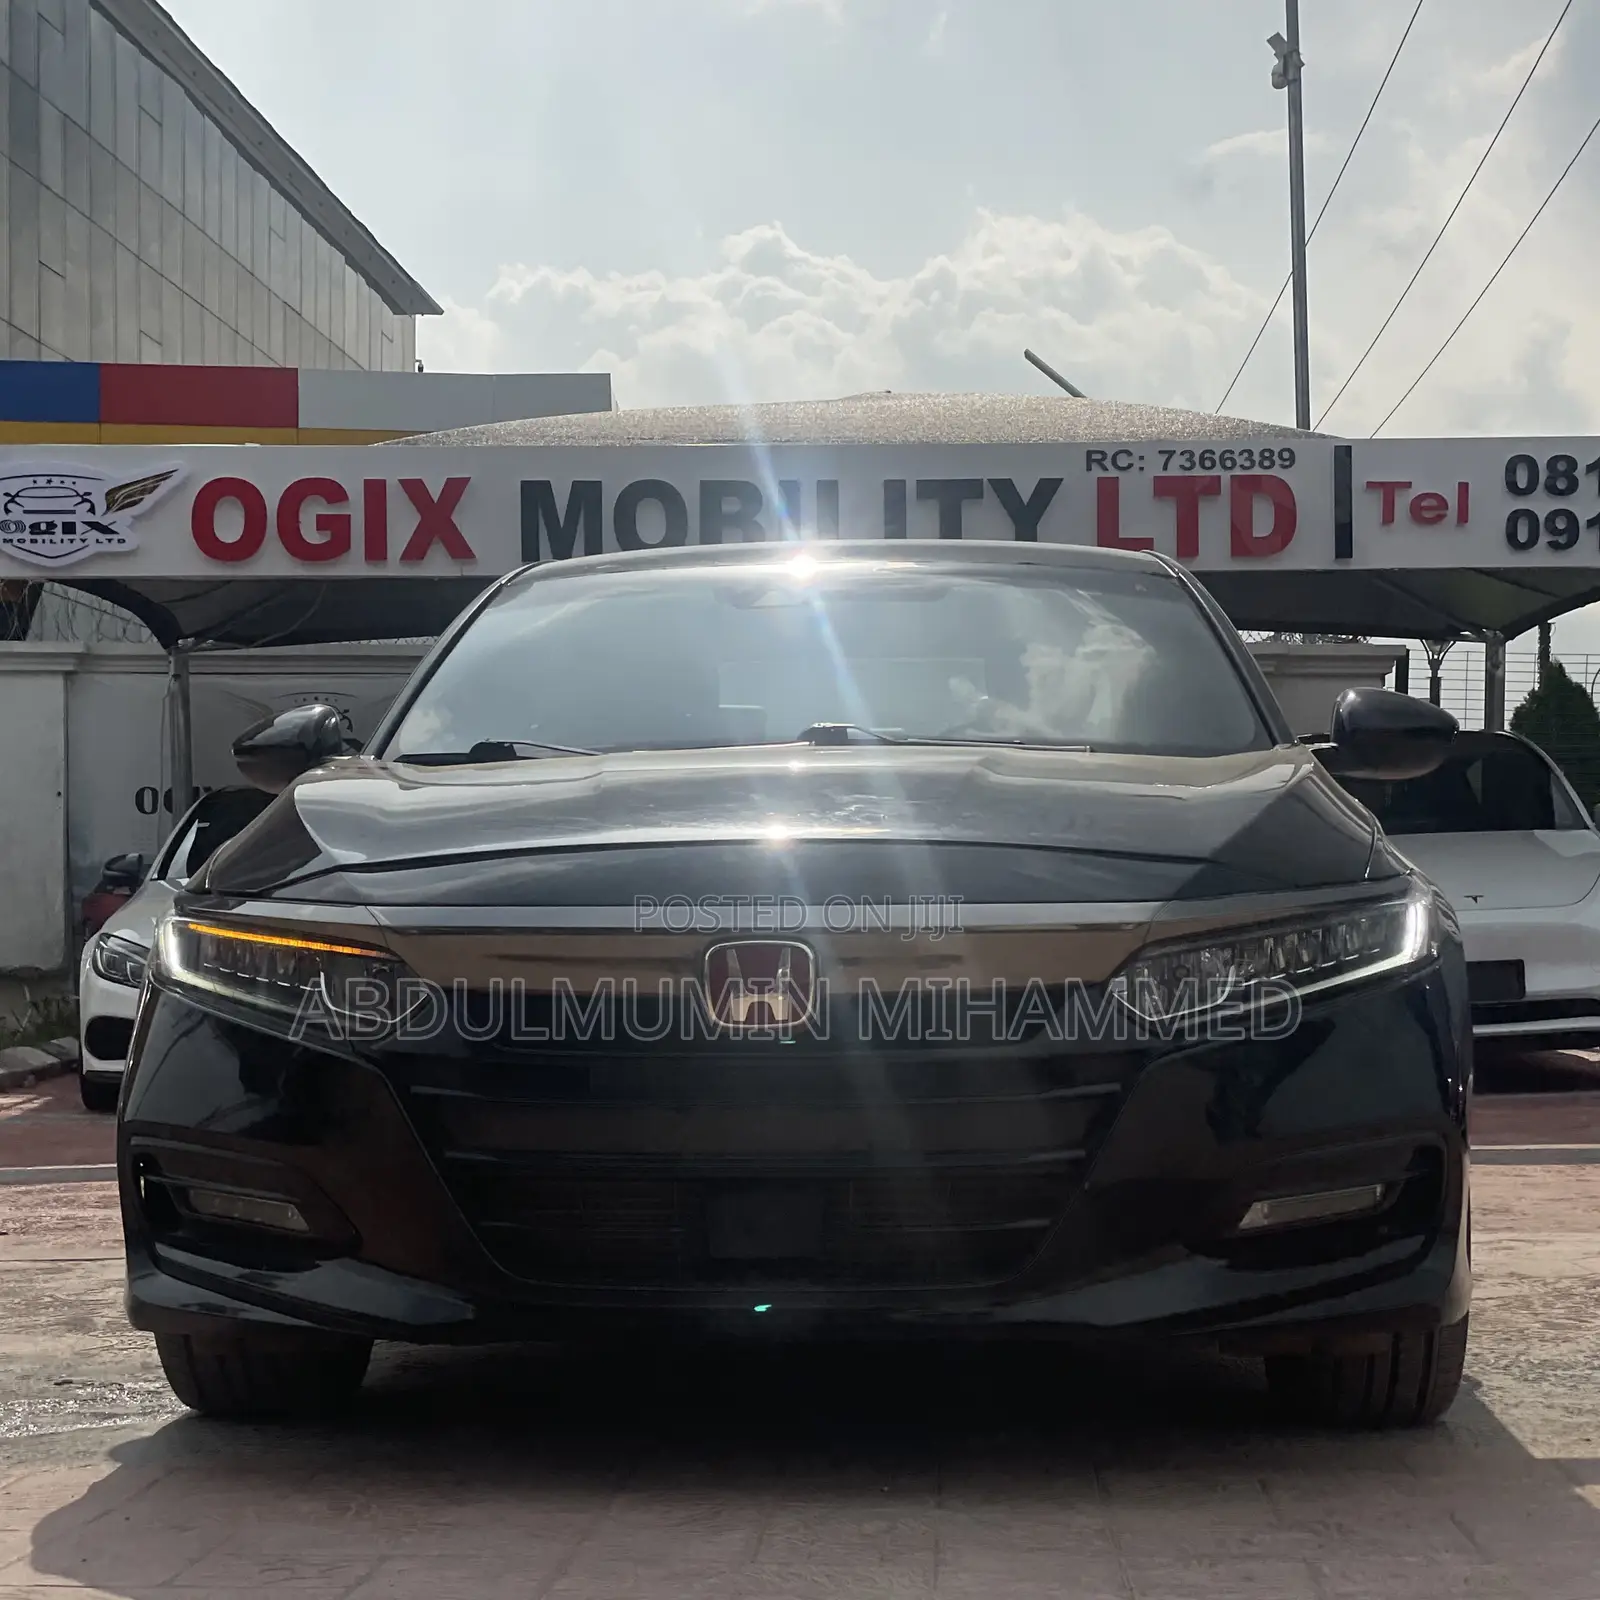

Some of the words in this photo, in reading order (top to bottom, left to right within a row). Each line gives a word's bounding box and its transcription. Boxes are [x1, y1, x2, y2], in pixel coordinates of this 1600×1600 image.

[1086, 449, 1145, 472] RC:
[1158, 448, 1297, 471] 7366389
[191, 477, 477, 562] OGIX
[519, 478, 1064, 562] MOBILITY
[1097, 474, 1297, 558] LTD
[1366, 481, 1469, 525] Tel
